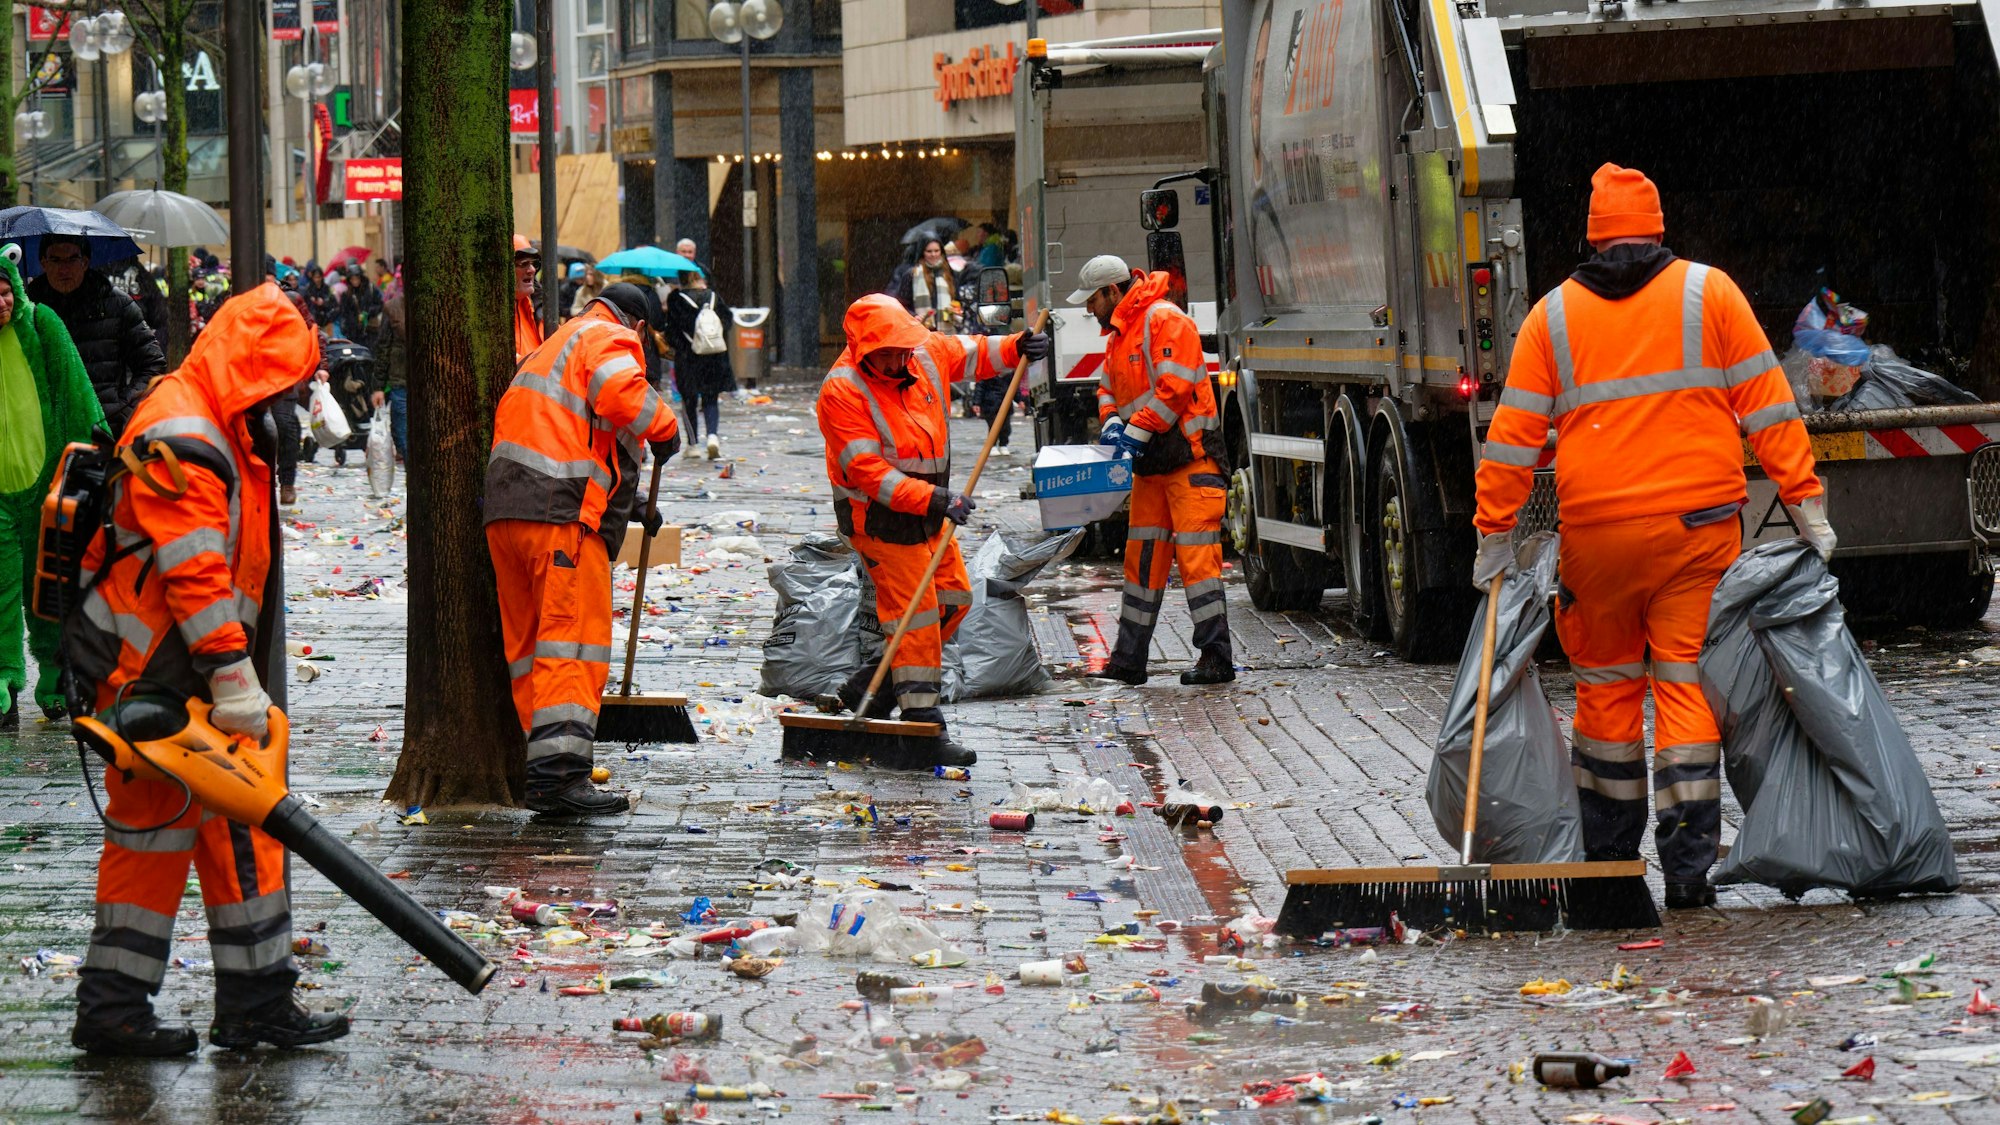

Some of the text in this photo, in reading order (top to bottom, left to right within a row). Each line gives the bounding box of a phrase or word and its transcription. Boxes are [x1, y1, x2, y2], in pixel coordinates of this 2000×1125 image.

[1039, 467, 1092, 492] I like it!
[1753, 491, 1800, 538] A
